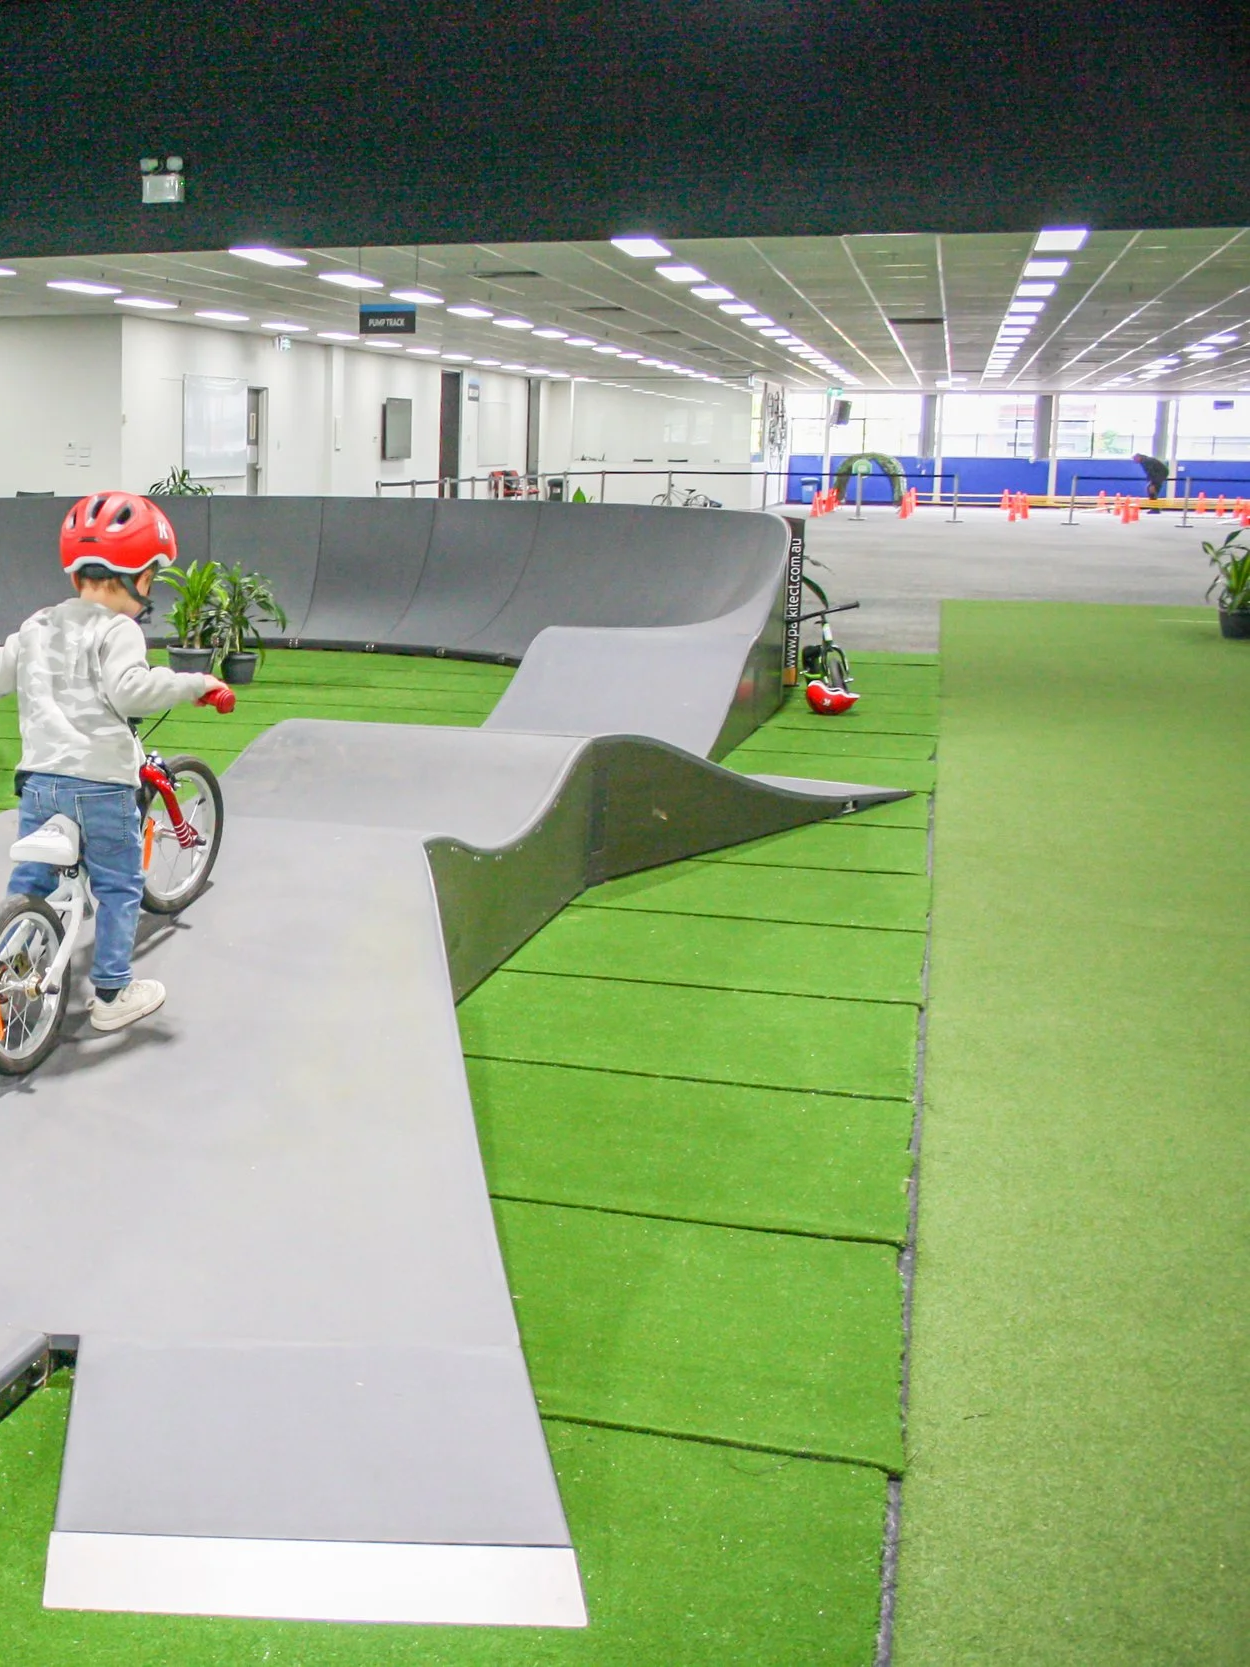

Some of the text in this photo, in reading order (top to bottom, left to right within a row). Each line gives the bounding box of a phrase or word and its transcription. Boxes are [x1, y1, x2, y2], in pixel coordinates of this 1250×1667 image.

[368, 317, 406, 327] PUMP TRACK
[785, 538, 803, 668] www.pakitect.com.au
